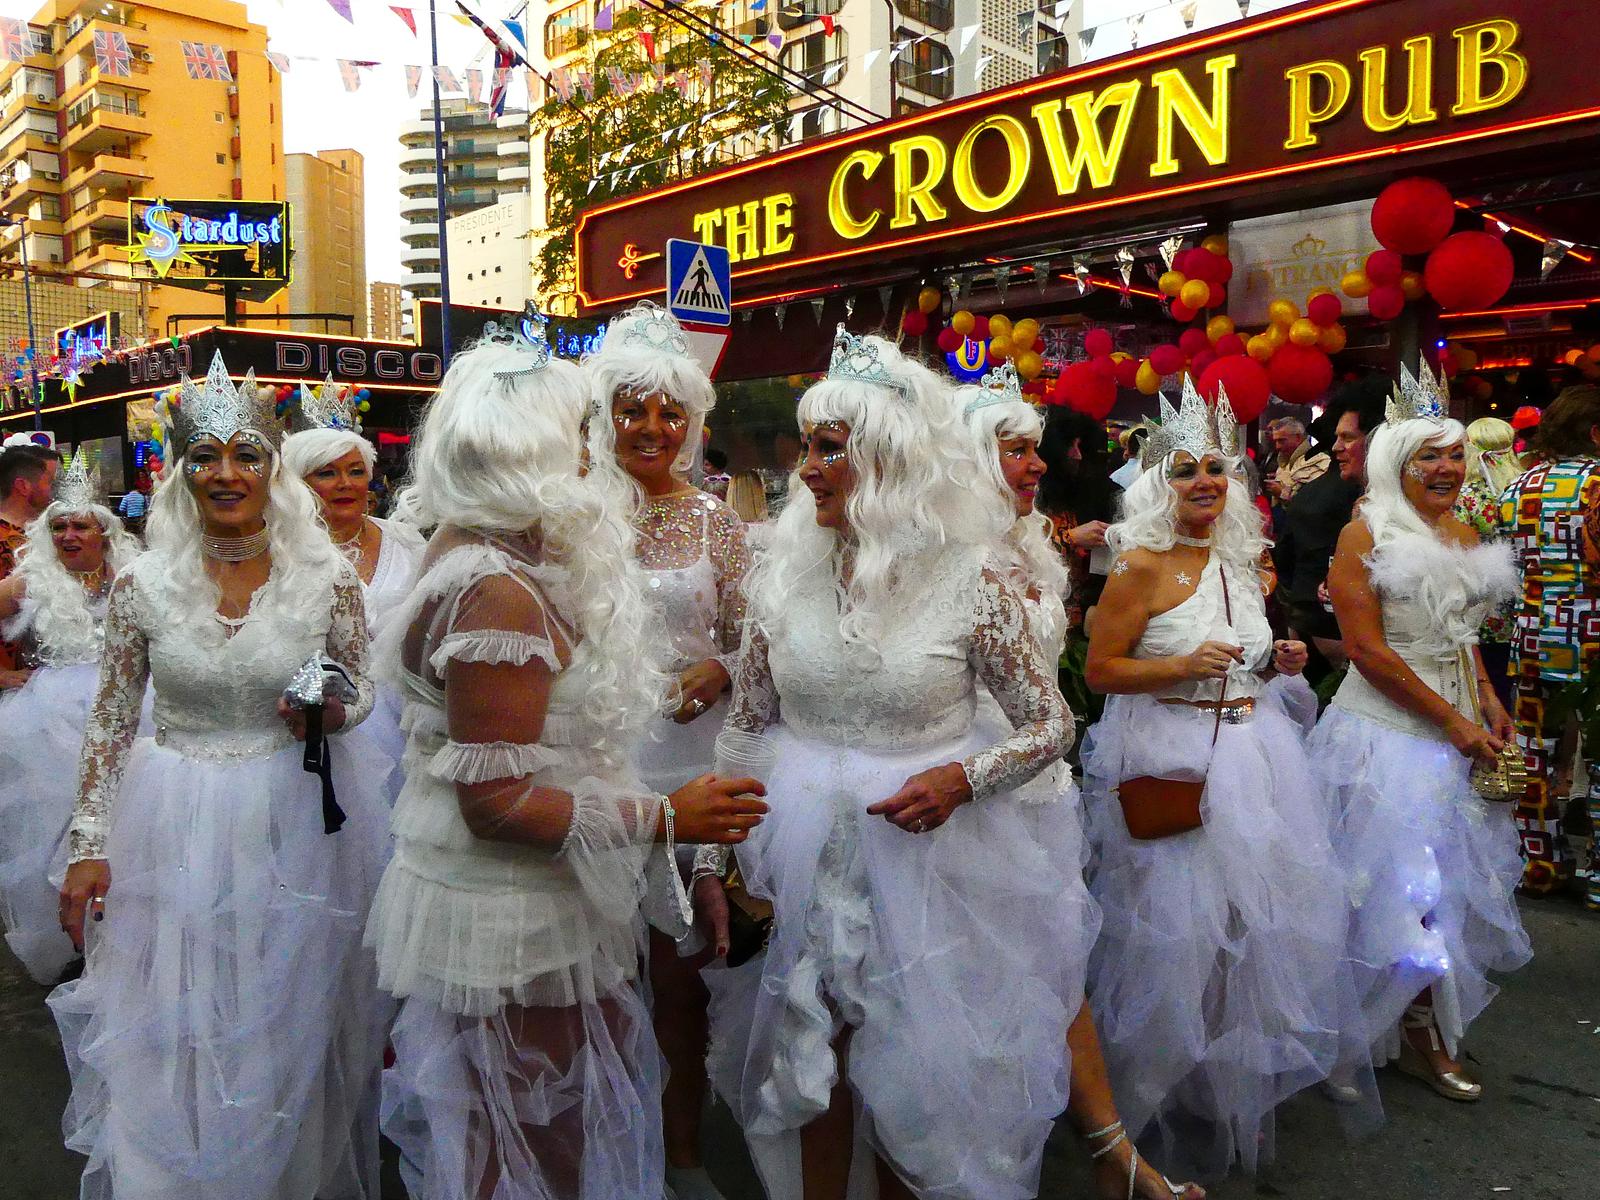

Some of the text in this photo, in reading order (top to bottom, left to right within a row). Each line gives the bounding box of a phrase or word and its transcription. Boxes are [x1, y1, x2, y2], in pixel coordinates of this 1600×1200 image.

[693, 18, 1529, 263] THE CROWN PUB
[144, 204, 282, 258] Stardust
[454, 203, 513, 233] PRESIDENTE
[128, 344, 193, 385] DISCO
[275, 341, 443, 381] DISCO
